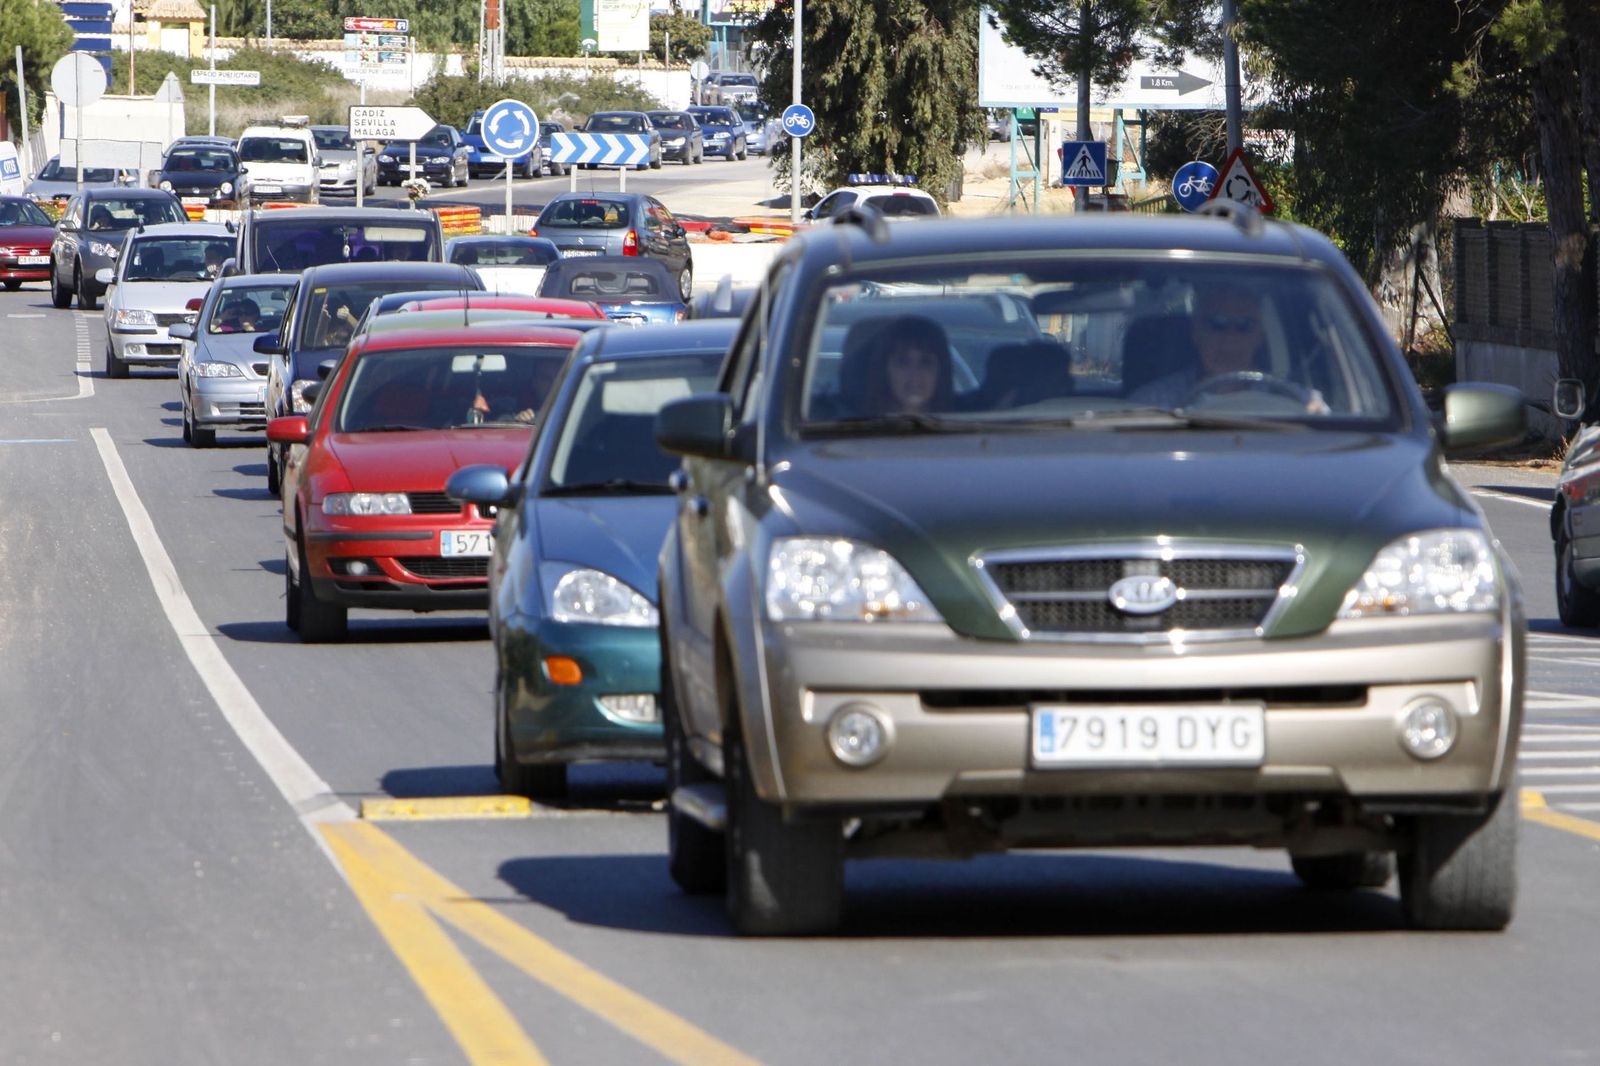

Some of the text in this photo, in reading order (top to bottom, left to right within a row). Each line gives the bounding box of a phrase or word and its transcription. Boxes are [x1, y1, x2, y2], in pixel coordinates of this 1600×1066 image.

[1151, 78, 1161, 87] 1.8
[354, 109, 385, 118] CADIZ
[354, 118, 396, 127] SEVILLA
[354, 128, 396, 137] MALAGA
[456, 534, 492, 553] 571
[1059, 716, 1250, 750] 7919 DYG
